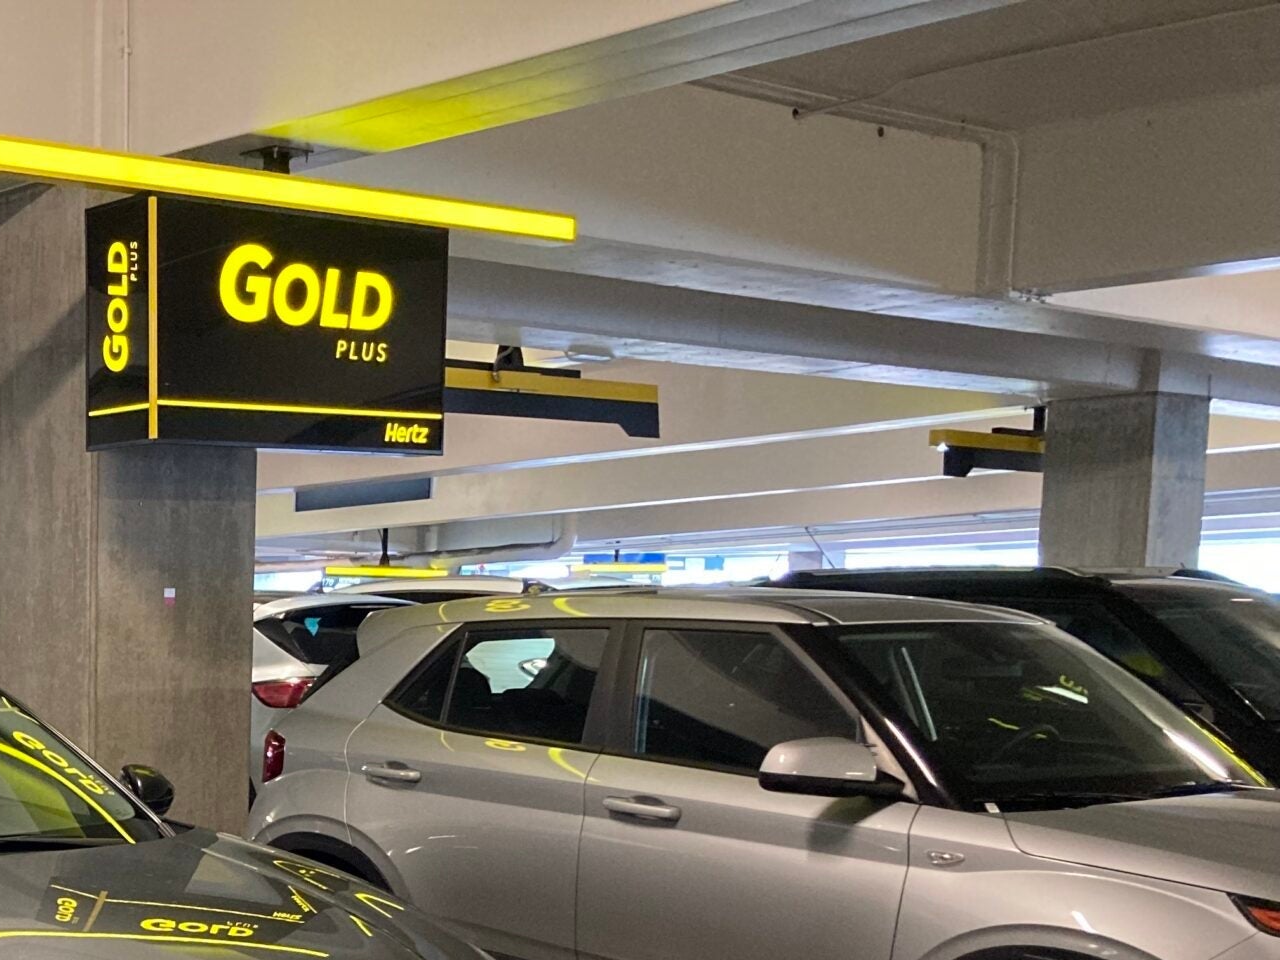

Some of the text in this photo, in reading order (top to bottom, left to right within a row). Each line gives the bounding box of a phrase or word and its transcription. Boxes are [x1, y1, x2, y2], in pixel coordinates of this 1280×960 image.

[129, 240, 139, 282] PLUS
[102, 241, 130, 373] GOLD
[219, 243, 394, 331] GOLD
[335, 340, 389, 363] PLUS
[384, 422, 429, 444] Hertz
